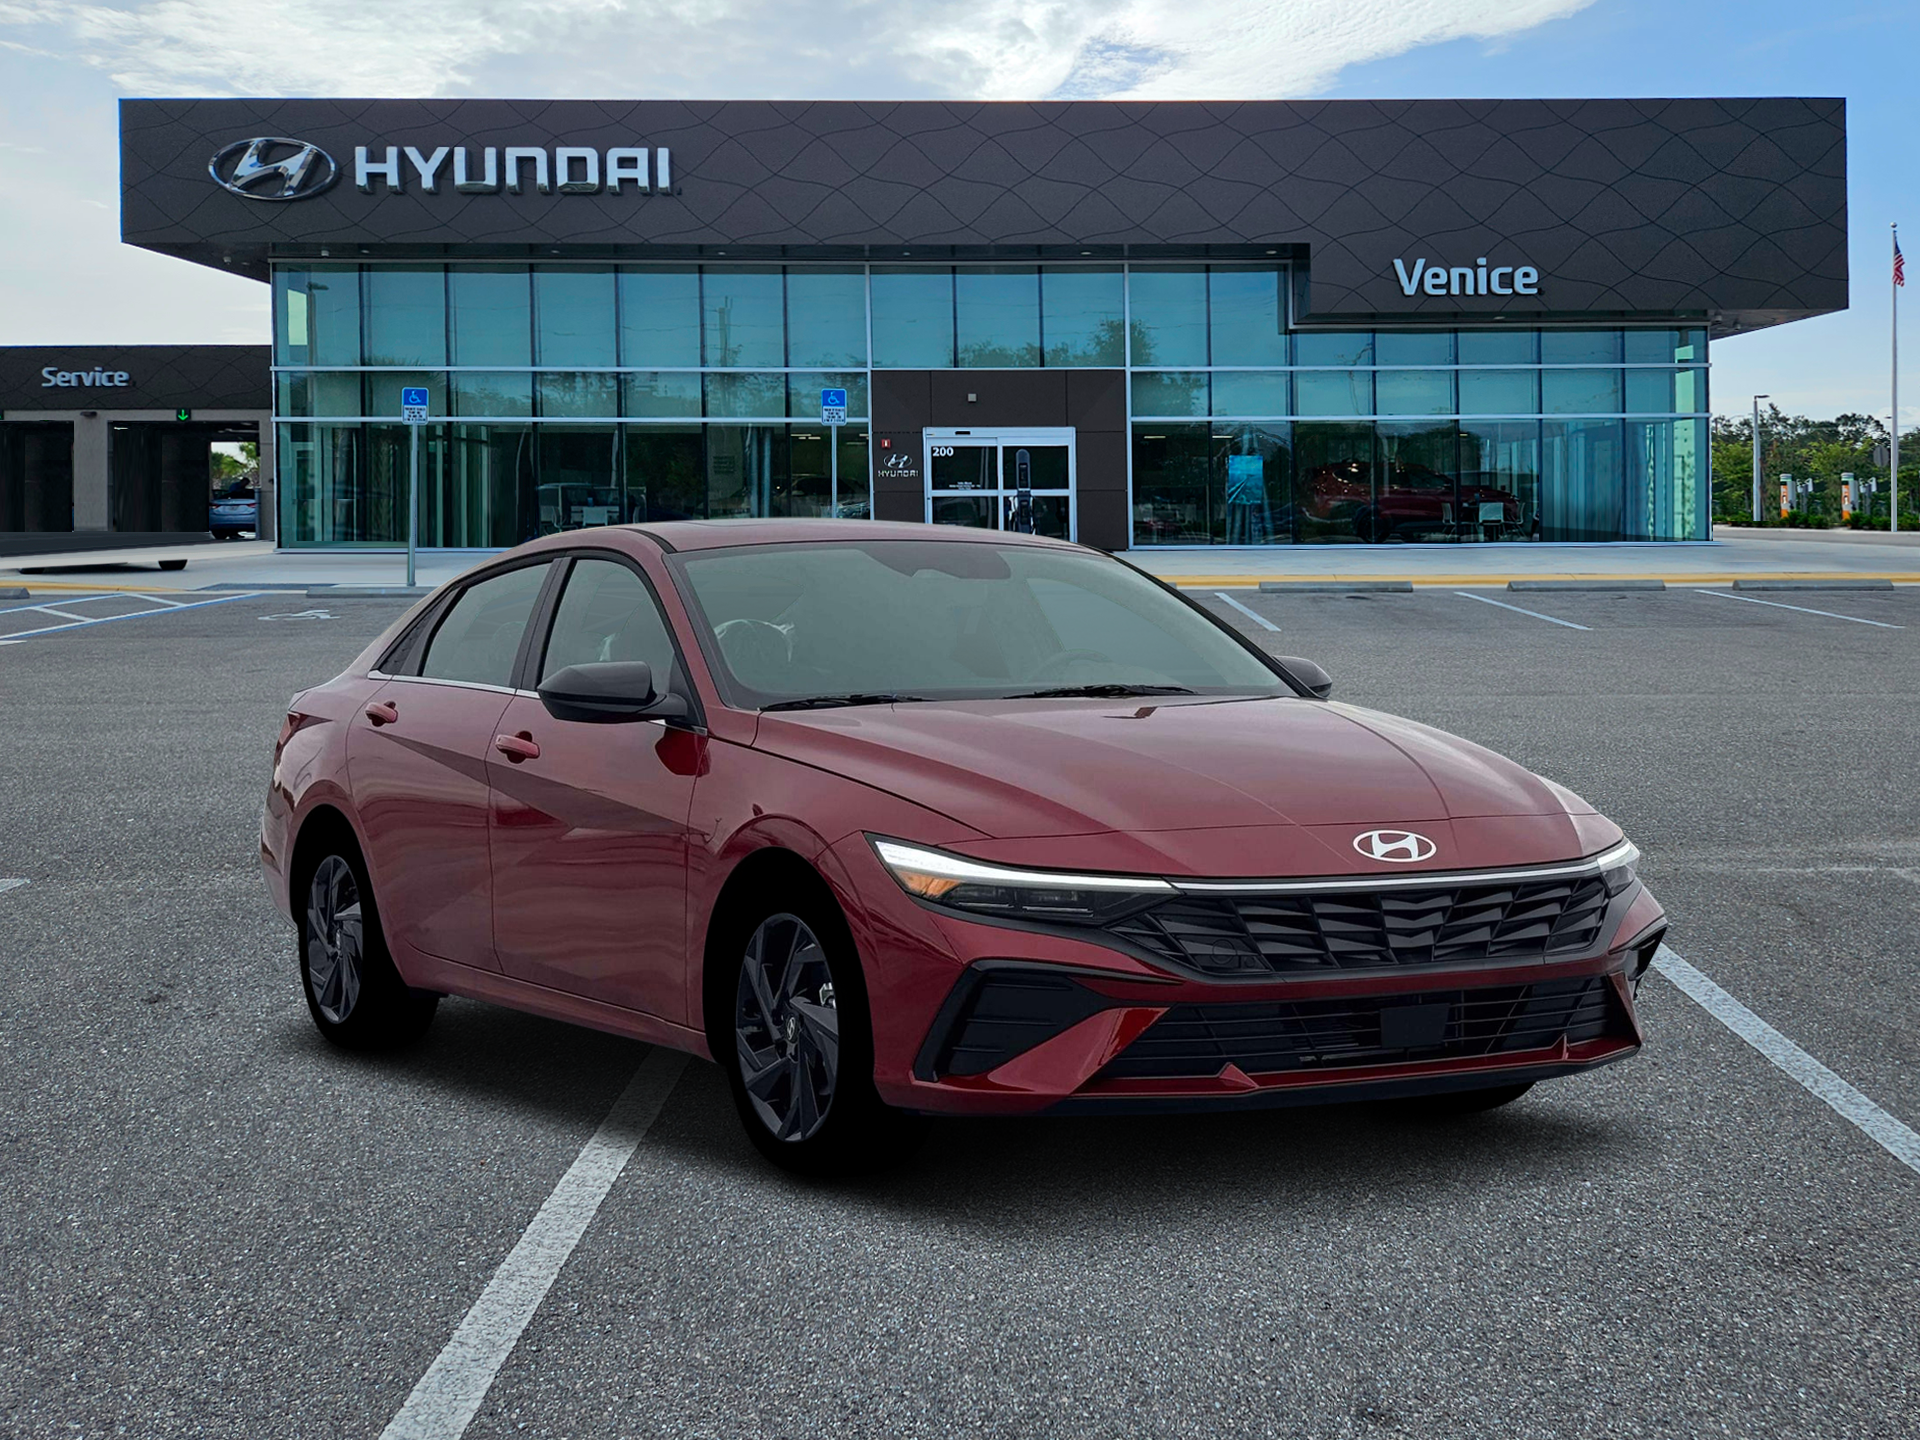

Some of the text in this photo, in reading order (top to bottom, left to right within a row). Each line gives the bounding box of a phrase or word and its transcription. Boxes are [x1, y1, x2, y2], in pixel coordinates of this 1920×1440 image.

[355, 147, 672, 194] HYUNDAI
[1393, 257, 1539, 295] Venice
[42, 366, 130, 387] Service
[932, 446, 954, 457] 200
[877, 470, 919, 478] HYUNDAI
